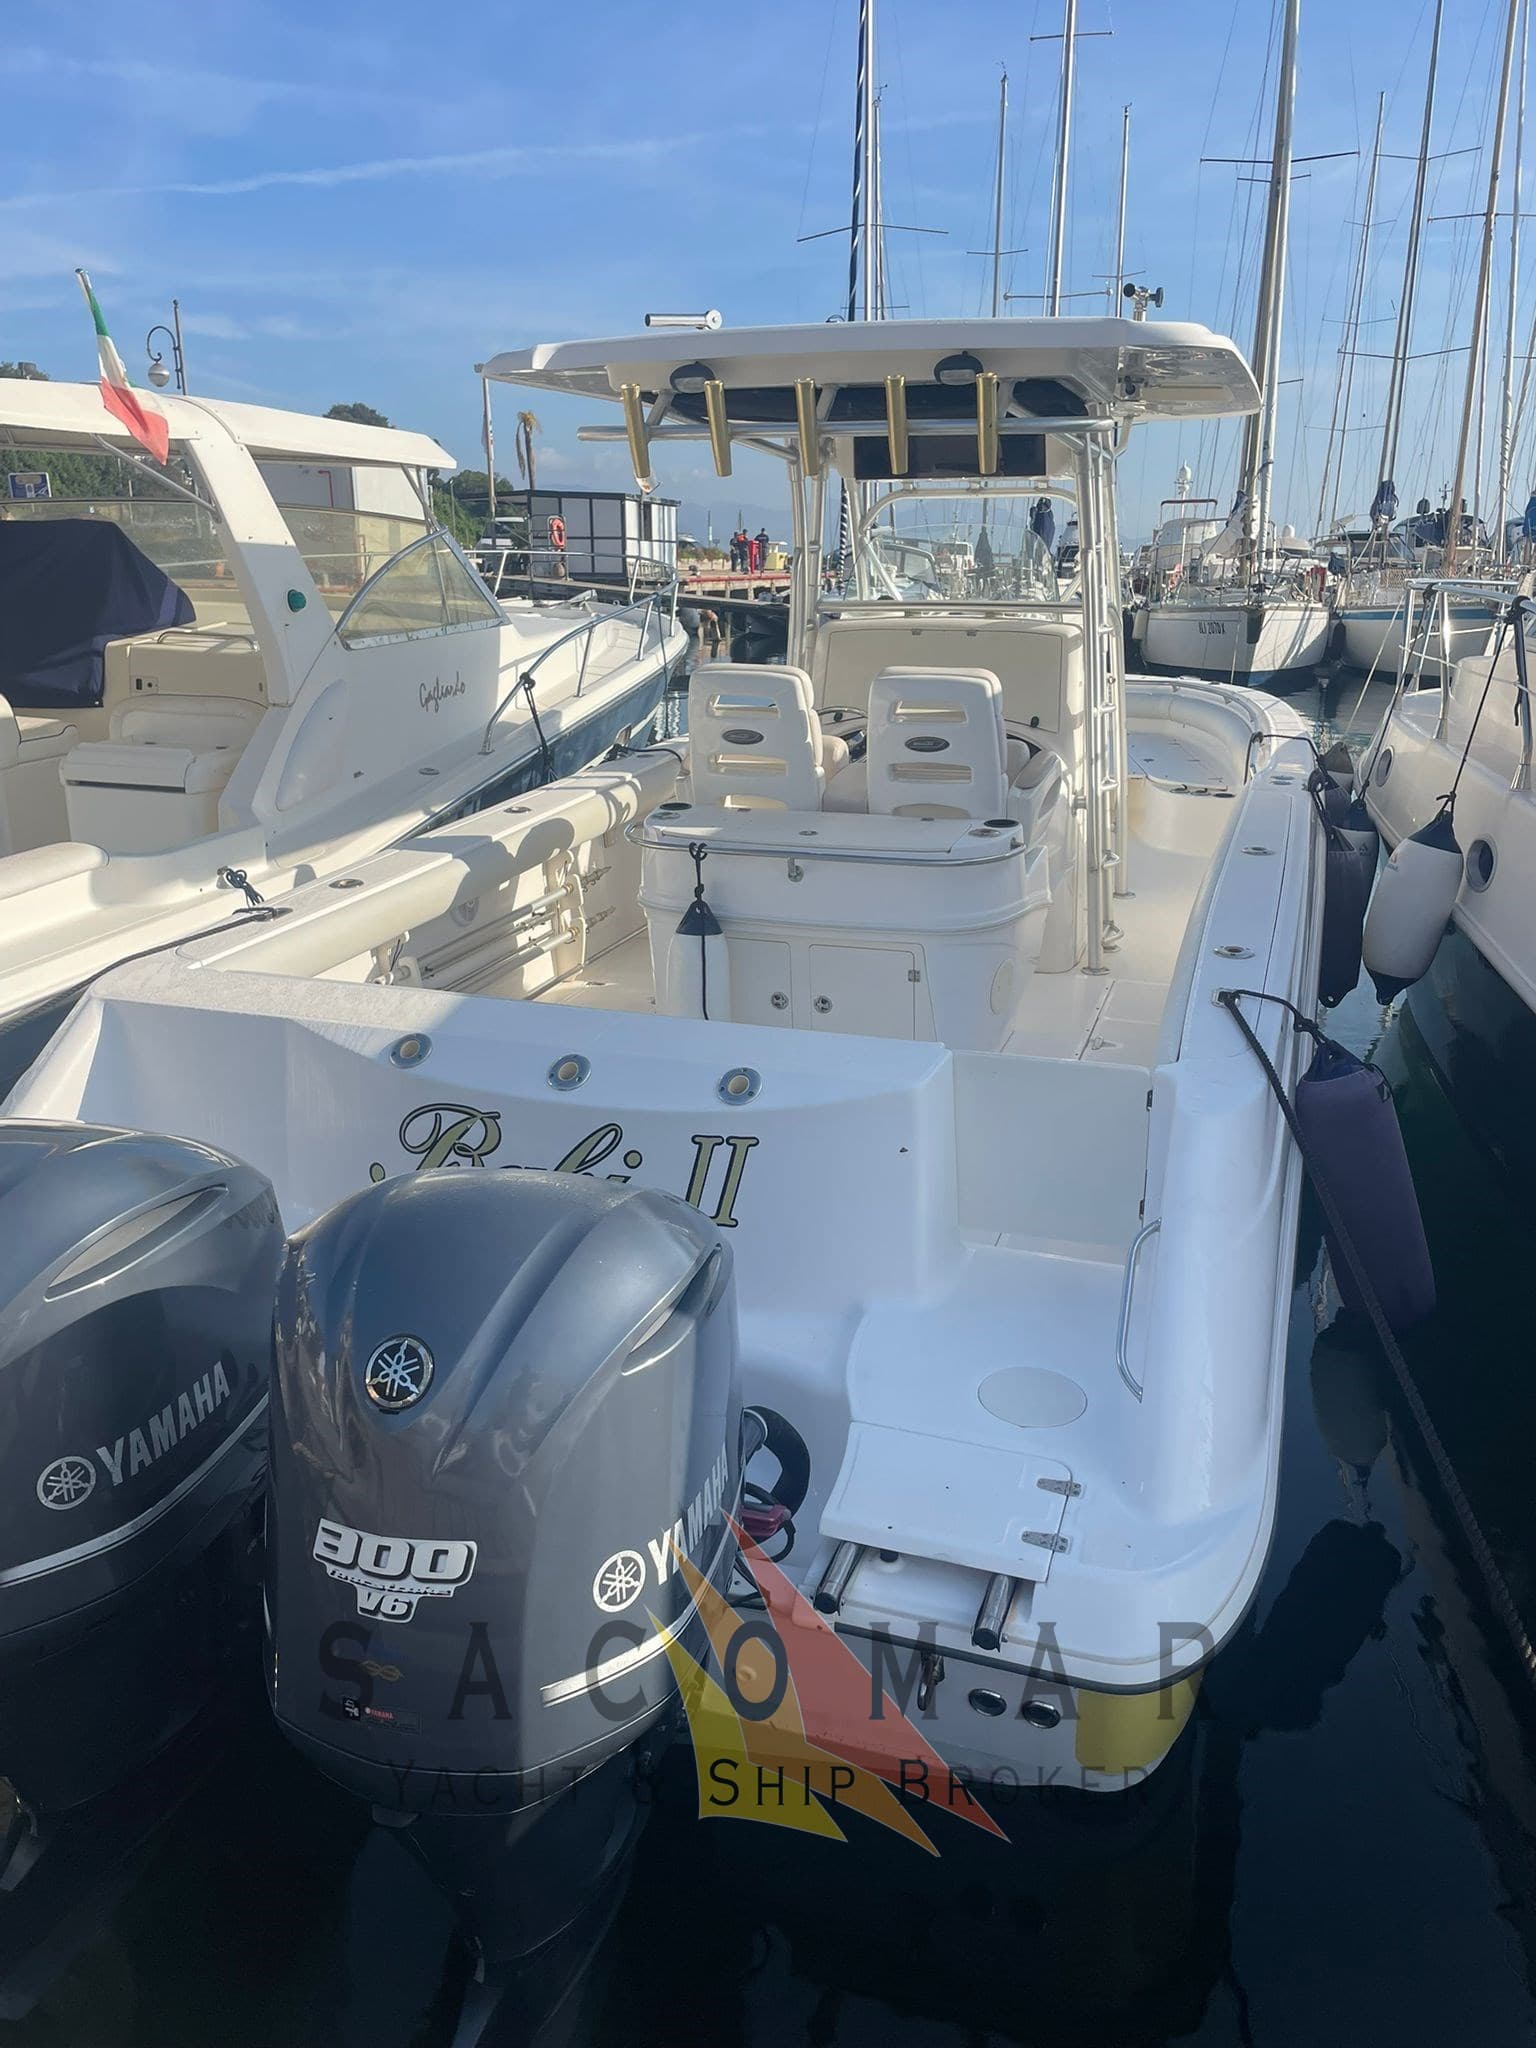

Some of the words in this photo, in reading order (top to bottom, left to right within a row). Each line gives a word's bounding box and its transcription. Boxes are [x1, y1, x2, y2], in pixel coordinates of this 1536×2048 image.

[95, 1360, 231, 1486] YAMAHA
[313, 1518, 476, 1583] 300
[647, 1441, 729, 1586] YAMAHA
[358, 1592, 414, 1621] V6
